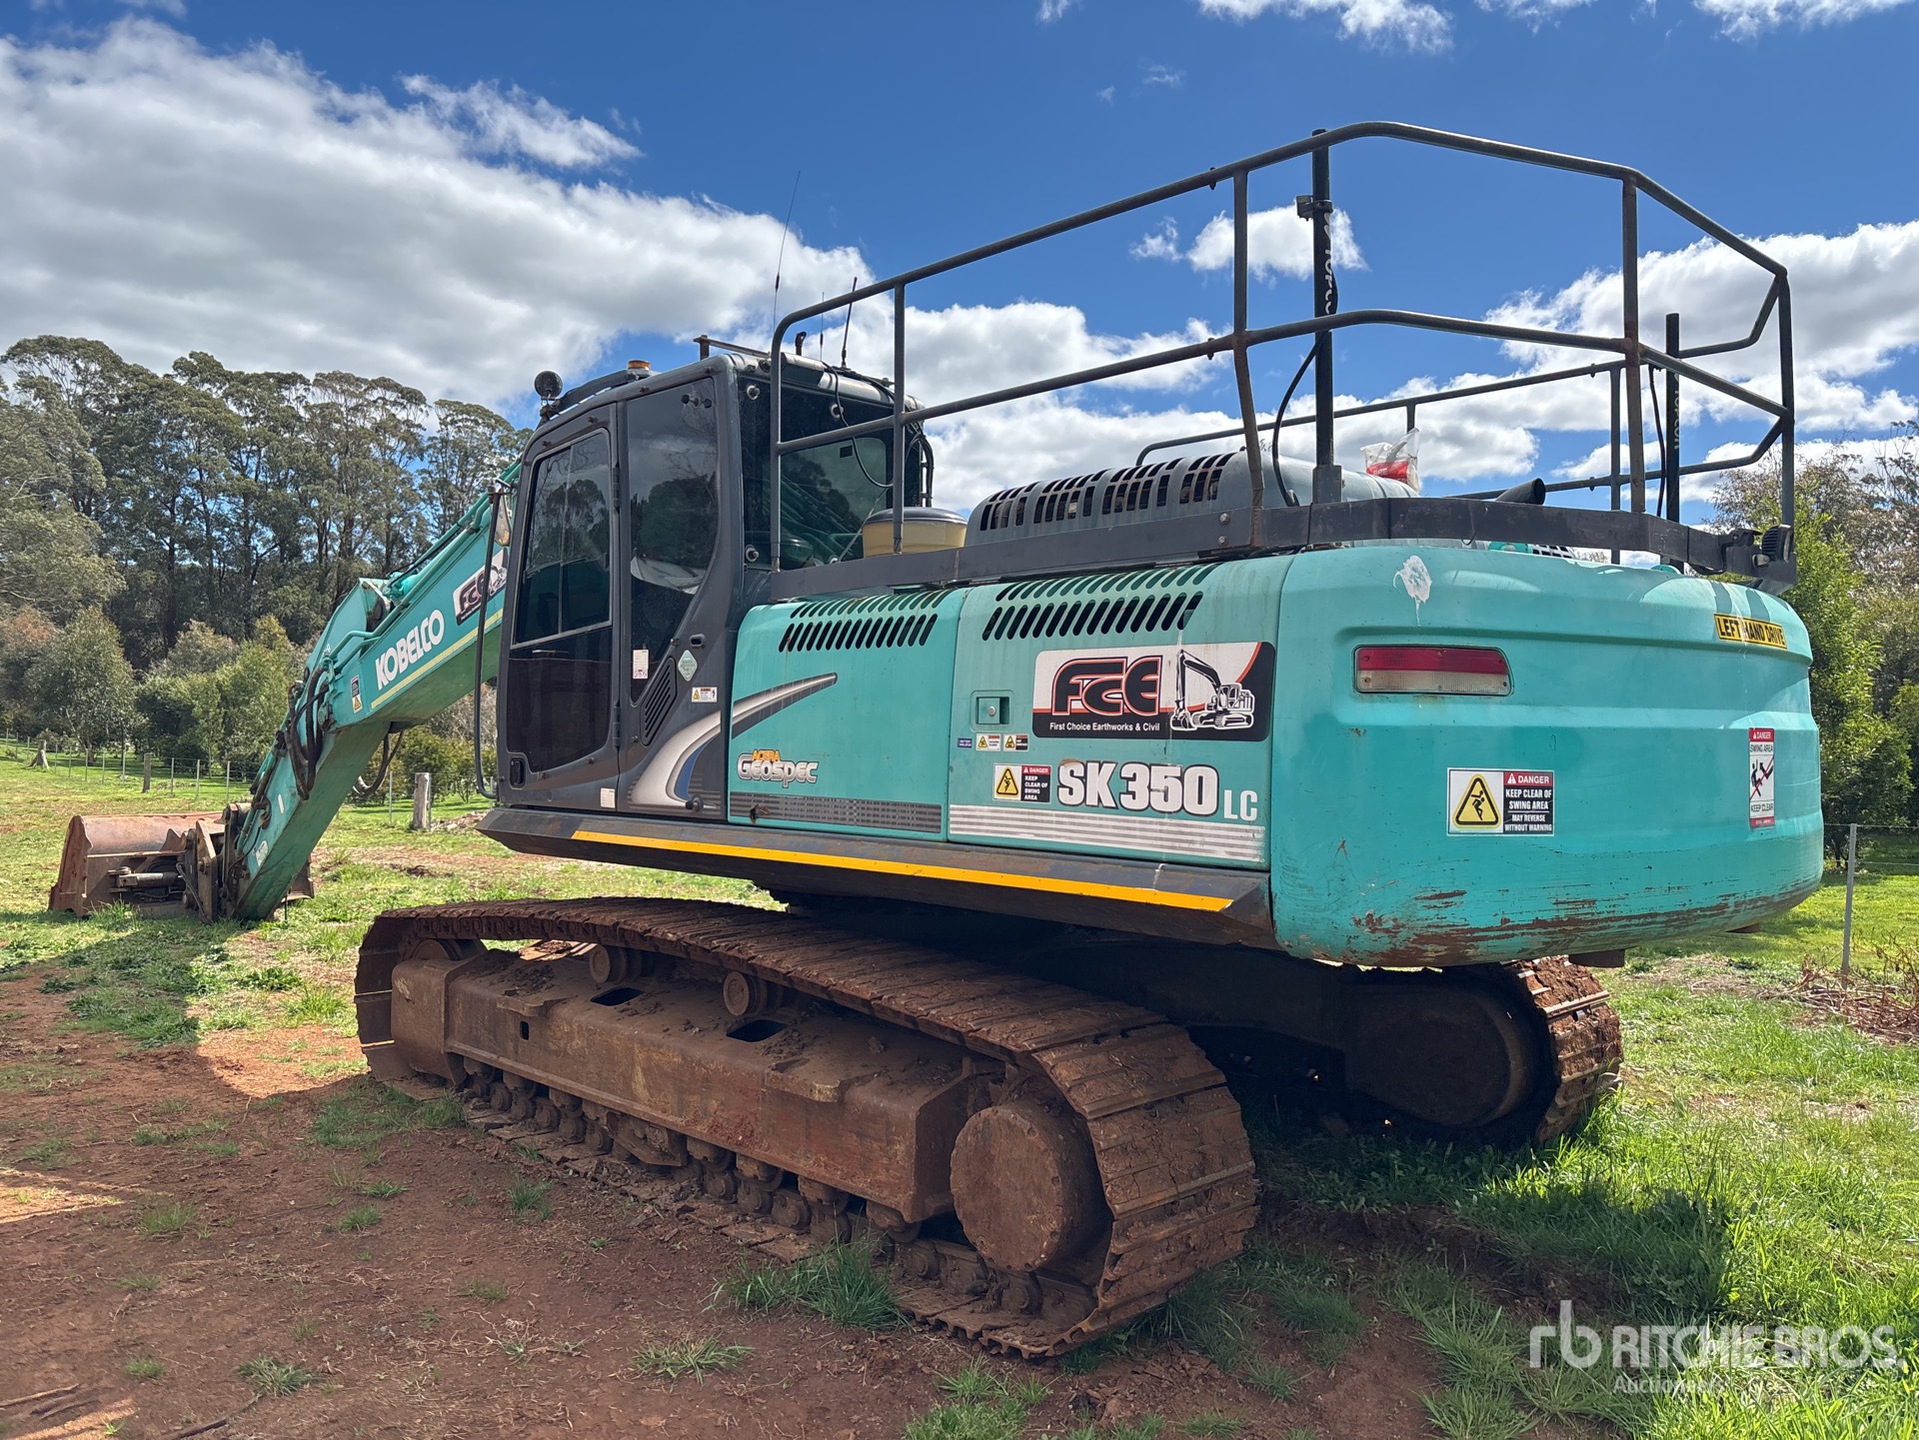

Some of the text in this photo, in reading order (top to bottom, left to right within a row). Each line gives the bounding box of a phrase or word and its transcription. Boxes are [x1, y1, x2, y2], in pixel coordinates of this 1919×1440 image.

[1717, 617, 1786, 645] LEFT HAND DRIVE
[375, 609, 445, 691] KOBELCO
[1051, 655, 1162, 716] FCE
[1049, 722, 1160, 731] First Choice Earthworks & Civil
[1756, 731, 1772, 739] DANGER
[1750, 744, 1773, 752] SWING AREA
[1517, 775, 1550, 784] DANGER
[1505, 789, 1552, 798] KEEP CLEAR OF
[1224, 789, 1258, 821] LC
[1509, 801, 1549, 810] SWING AREA
[1750, 803, 1774, 813] KEEP CLEAR
[1511, 814, 1546, 822] MAY REVERSE
[1505, 824, 1552, 832] WITHOUT WARNING
